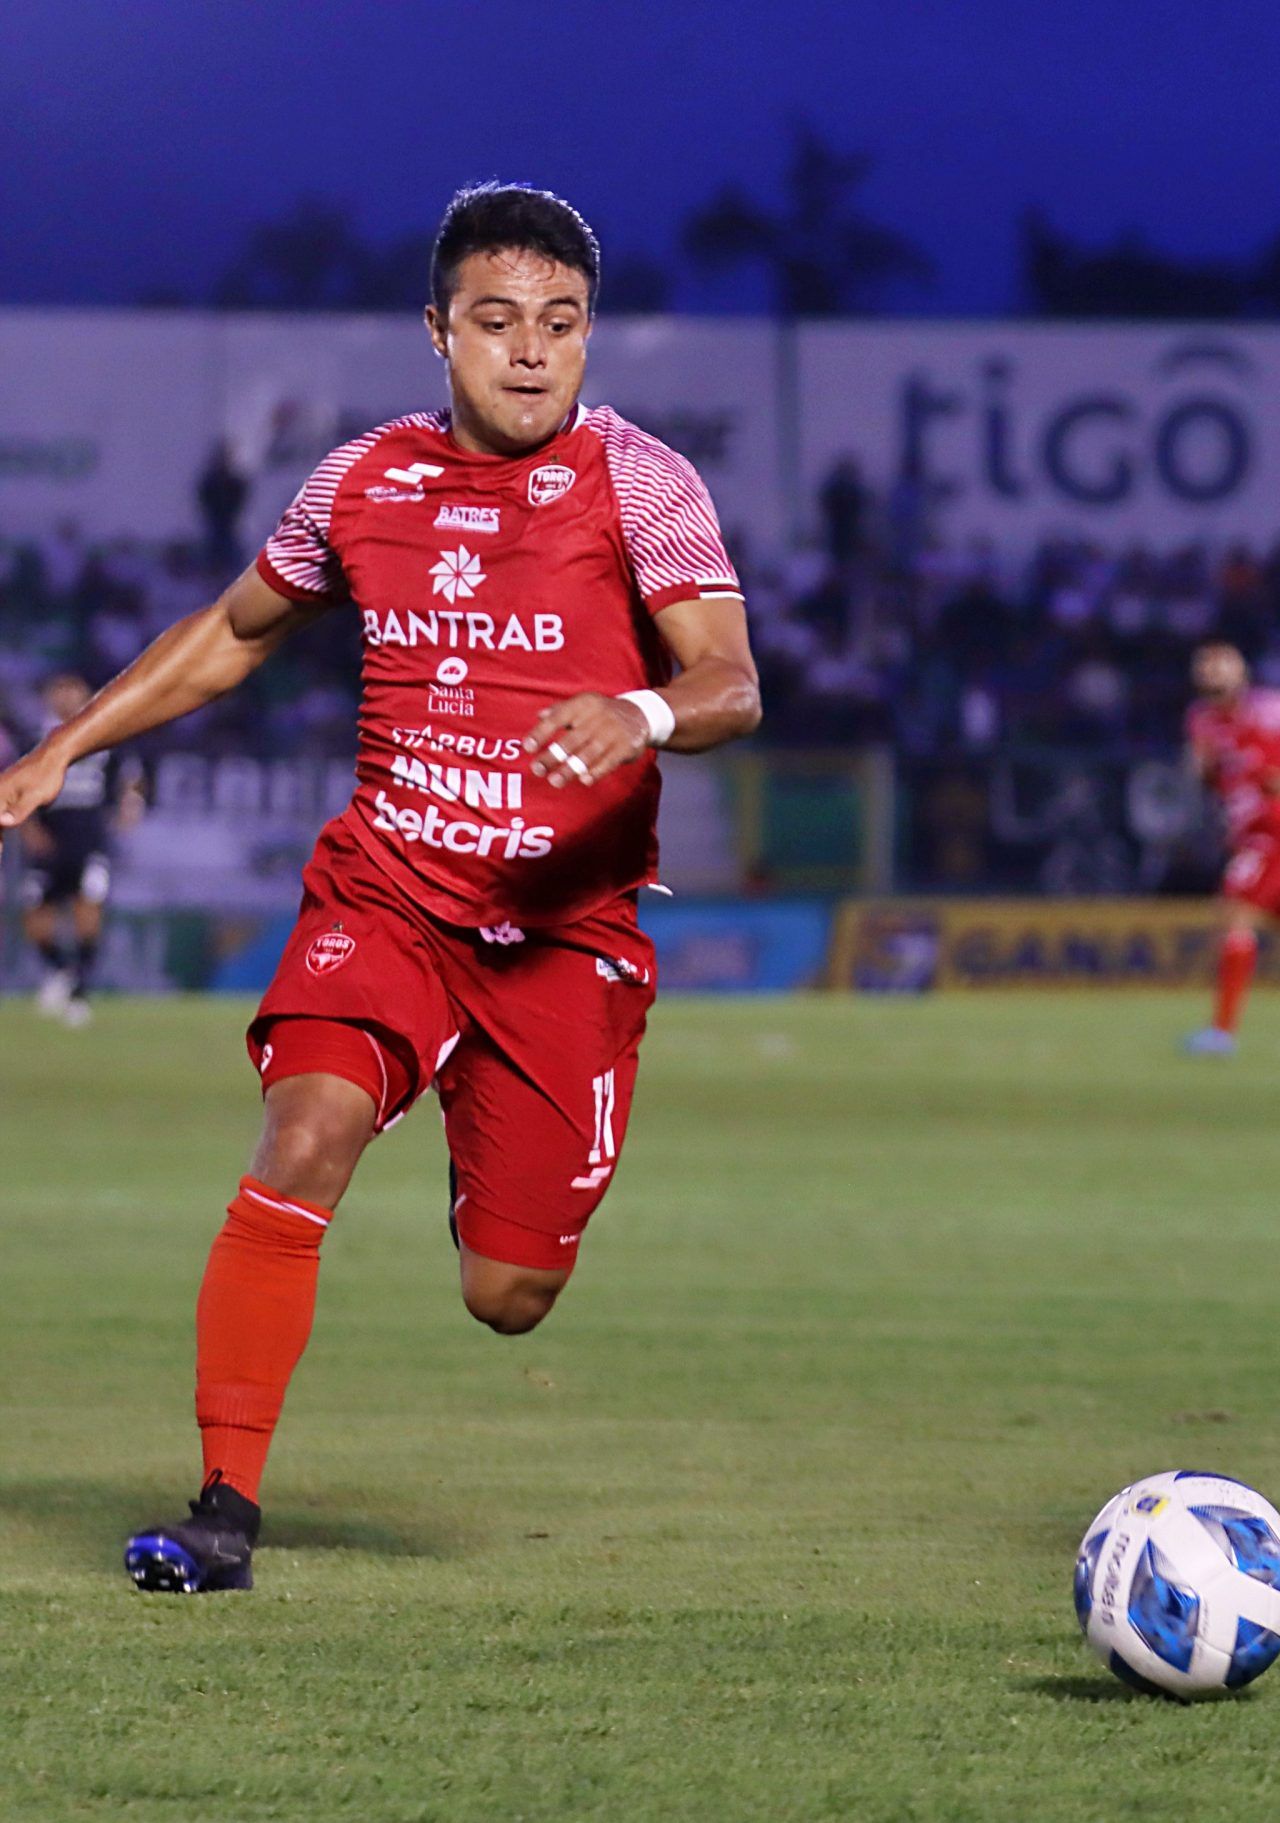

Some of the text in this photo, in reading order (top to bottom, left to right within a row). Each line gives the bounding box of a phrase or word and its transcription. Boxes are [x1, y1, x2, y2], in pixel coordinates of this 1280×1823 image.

[536, 470, 570, 486] TOROS
[438, 505, 500, 524] BATRES
[363, 608, 566, 652] BANTRAB
[428, 683, 475, 700] Santa
[391, 724, 522, 761] STARBUS
[390, 754, 523, 809] MUNI
[373, 790, 555, 860] betcris
